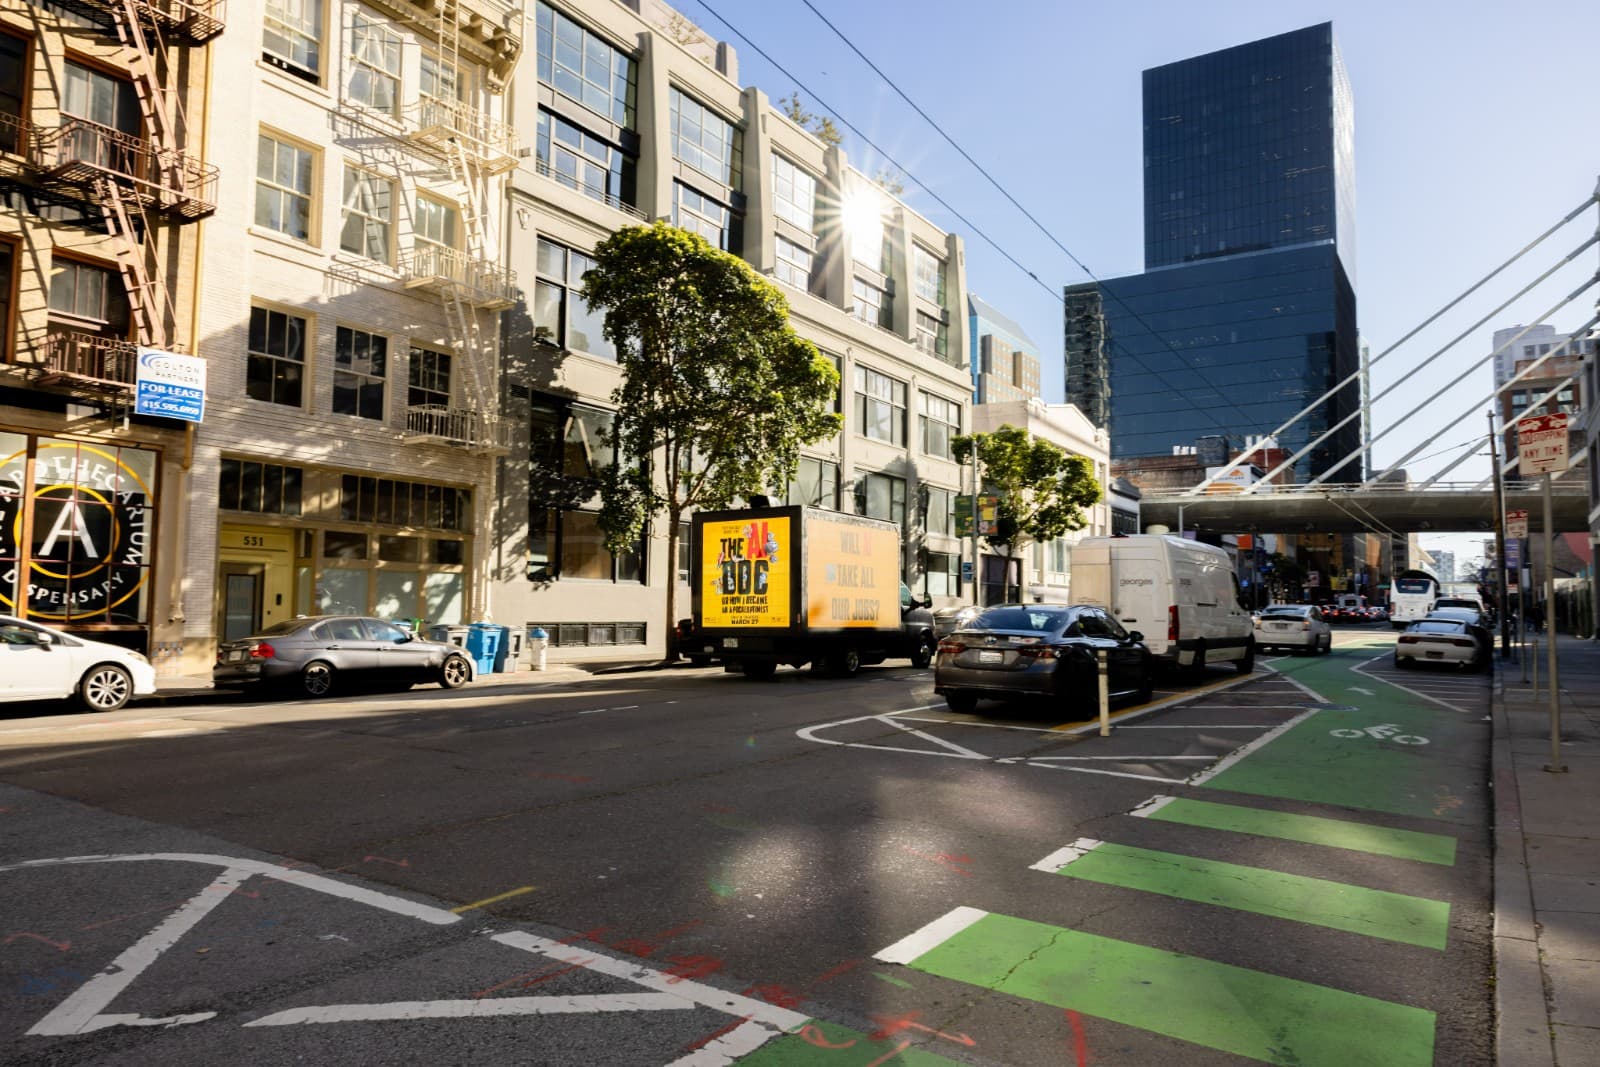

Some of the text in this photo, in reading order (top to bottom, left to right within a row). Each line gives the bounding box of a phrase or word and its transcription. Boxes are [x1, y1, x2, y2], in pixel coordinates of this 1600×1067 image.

[140, 382, 202, 399] FOR LEASE
[1532, 430, 1566, 442] STOPPING
[1524, 444, 1564, 458] ANY TIME
[38, 495, 99, 558] A
[243, 536, 264, 547] 531
[720, 521, 769, 559] THE AI
[2, 568, 125, 605] DSPENSARY
[722, 559, 769, 595] DOC
